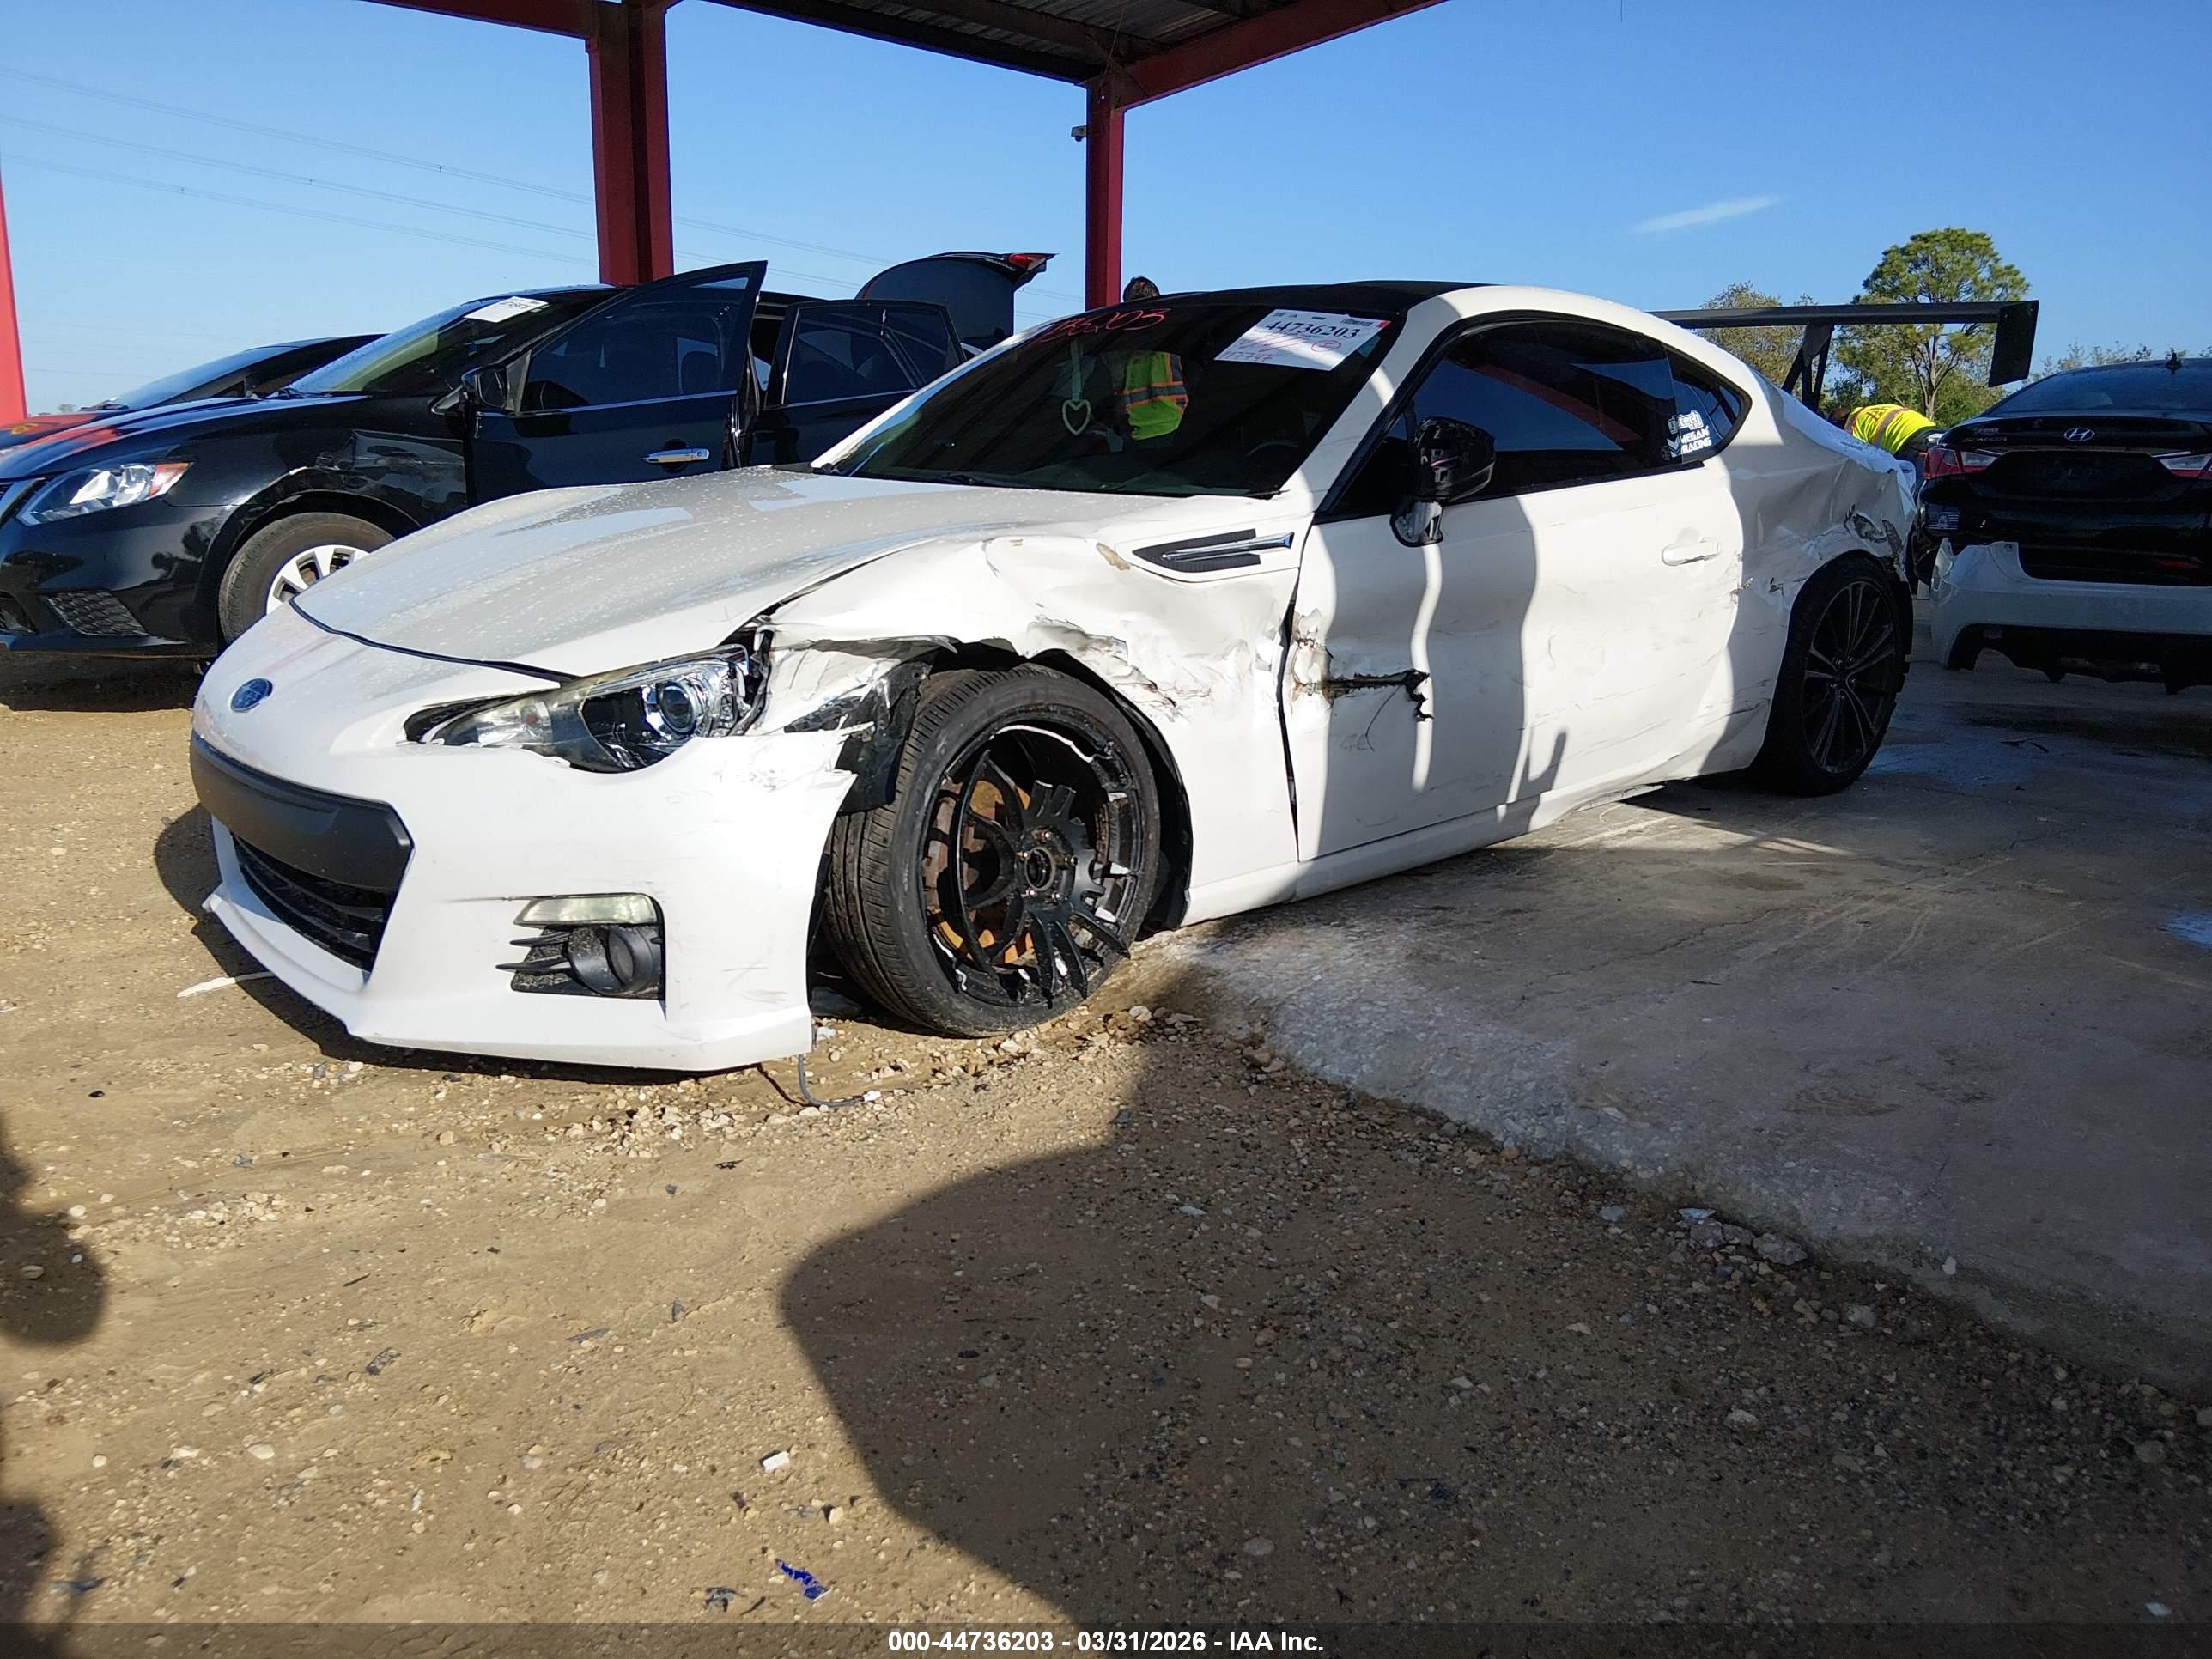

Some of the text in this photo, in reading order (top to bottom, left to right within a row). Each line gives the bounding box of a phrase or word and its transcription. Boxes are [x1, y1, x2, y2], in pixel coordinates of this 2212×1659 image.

[1266, 320, 1362, 338] 44736203
[1680, 425, 1710, 444] MEGAN
[1680, 436, 1712, 455] RACING
